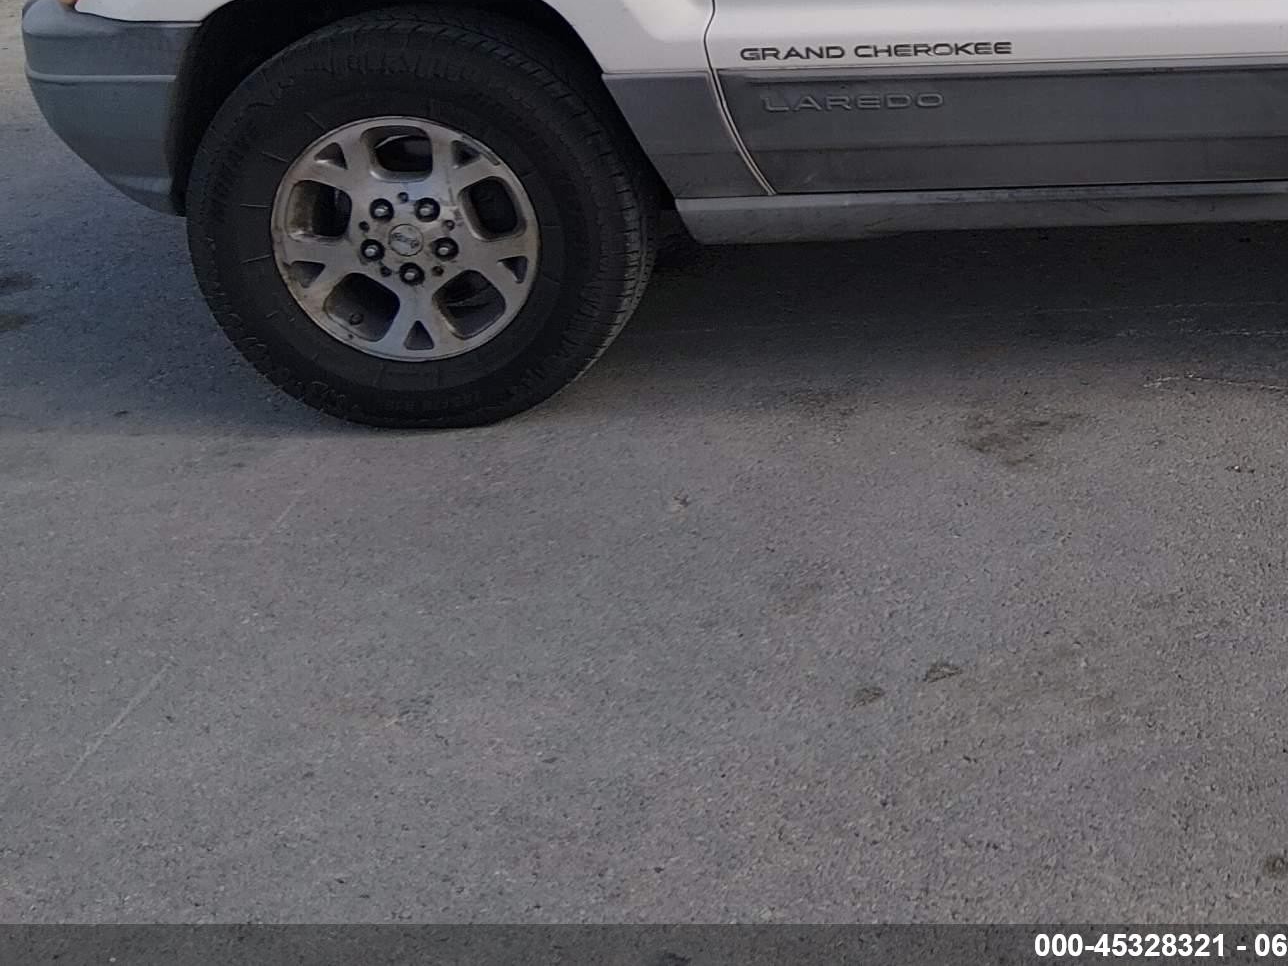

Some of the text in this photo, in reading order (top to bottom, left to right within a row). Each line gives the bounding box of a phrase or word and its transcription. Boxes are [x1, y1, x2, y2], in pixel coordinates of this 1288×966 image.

[740, 41, 1012, 61] GRAND CHEROKEE
[761, 93, 944, 113] LAREDO
